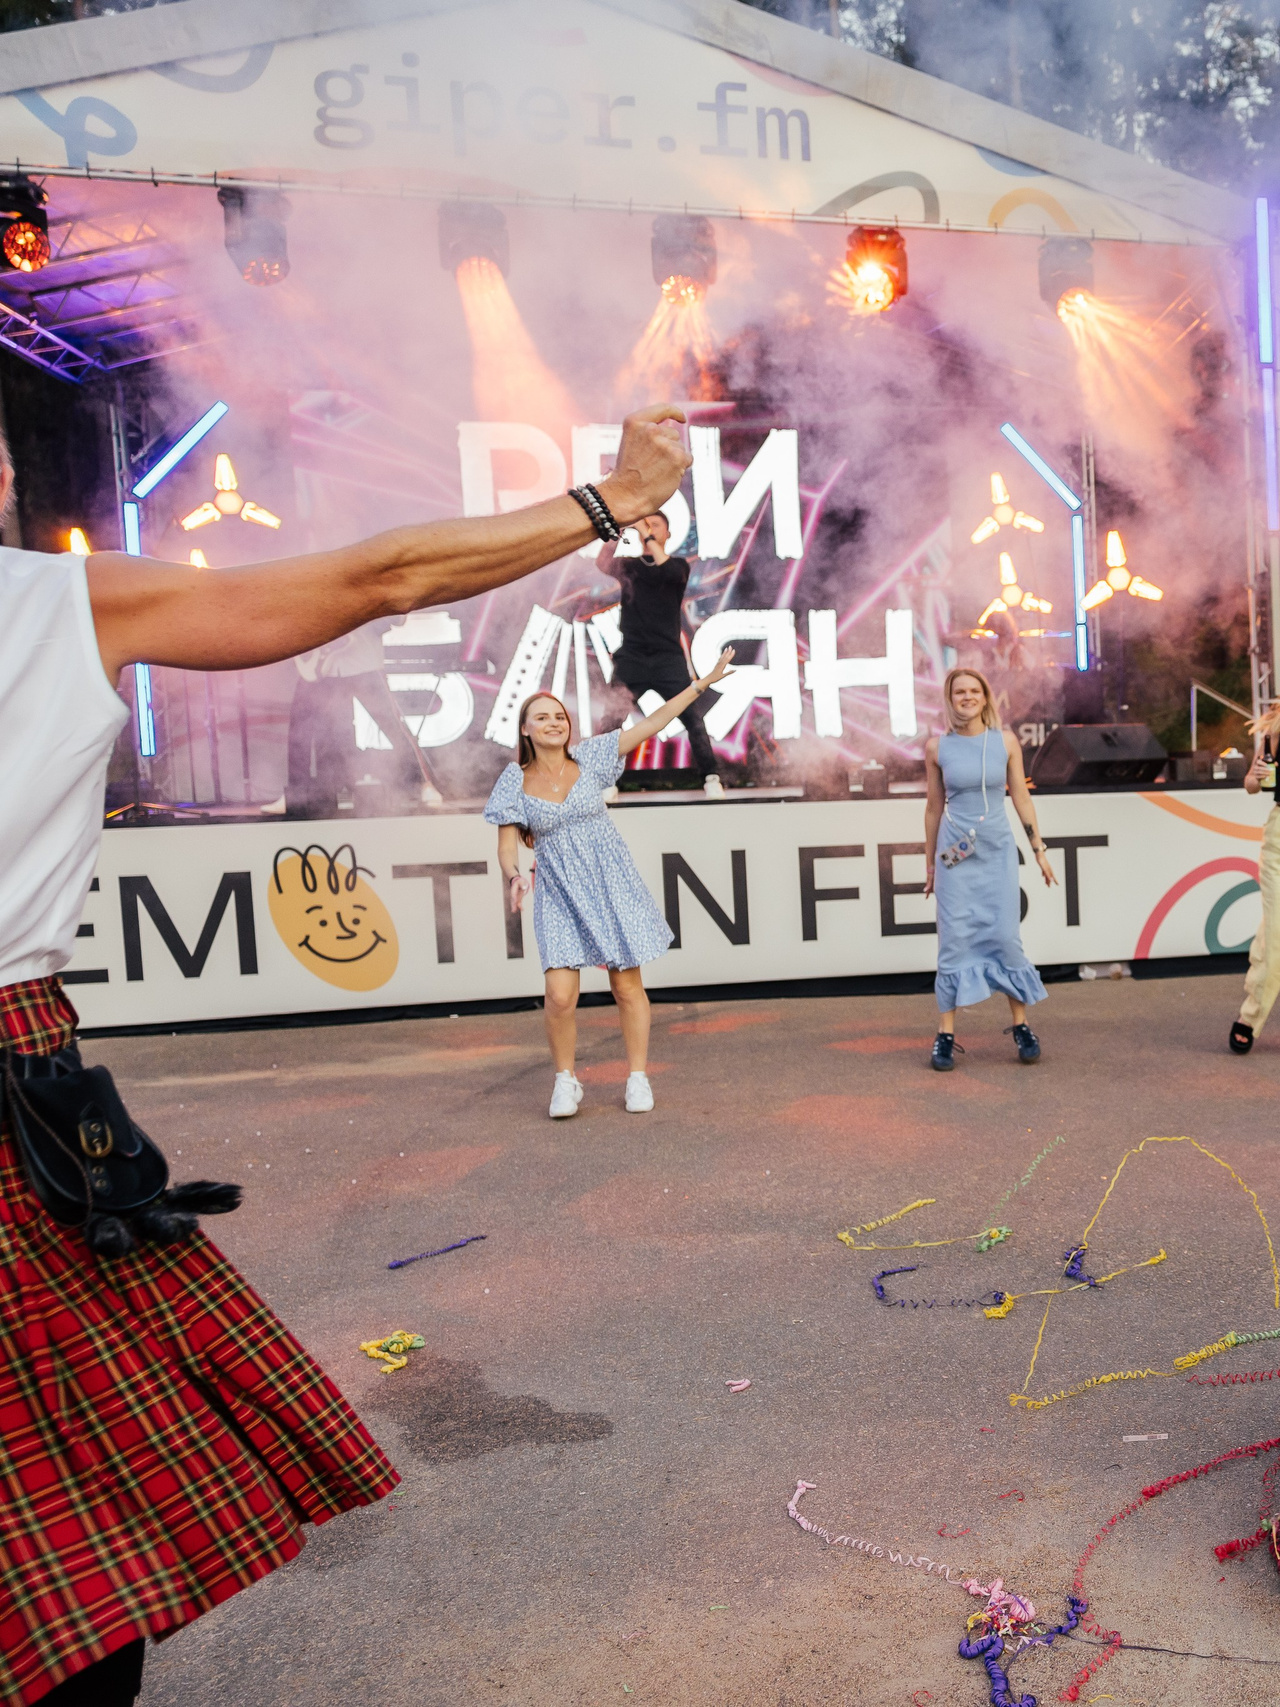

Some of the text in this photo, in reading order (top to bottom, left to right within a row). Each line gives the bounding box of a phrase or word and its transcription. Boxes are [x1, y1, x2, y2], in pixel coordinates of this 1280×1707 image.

[313, 52, 811, 162] giper.fm
[62, 834, 1108, 991] MOTIN FET
